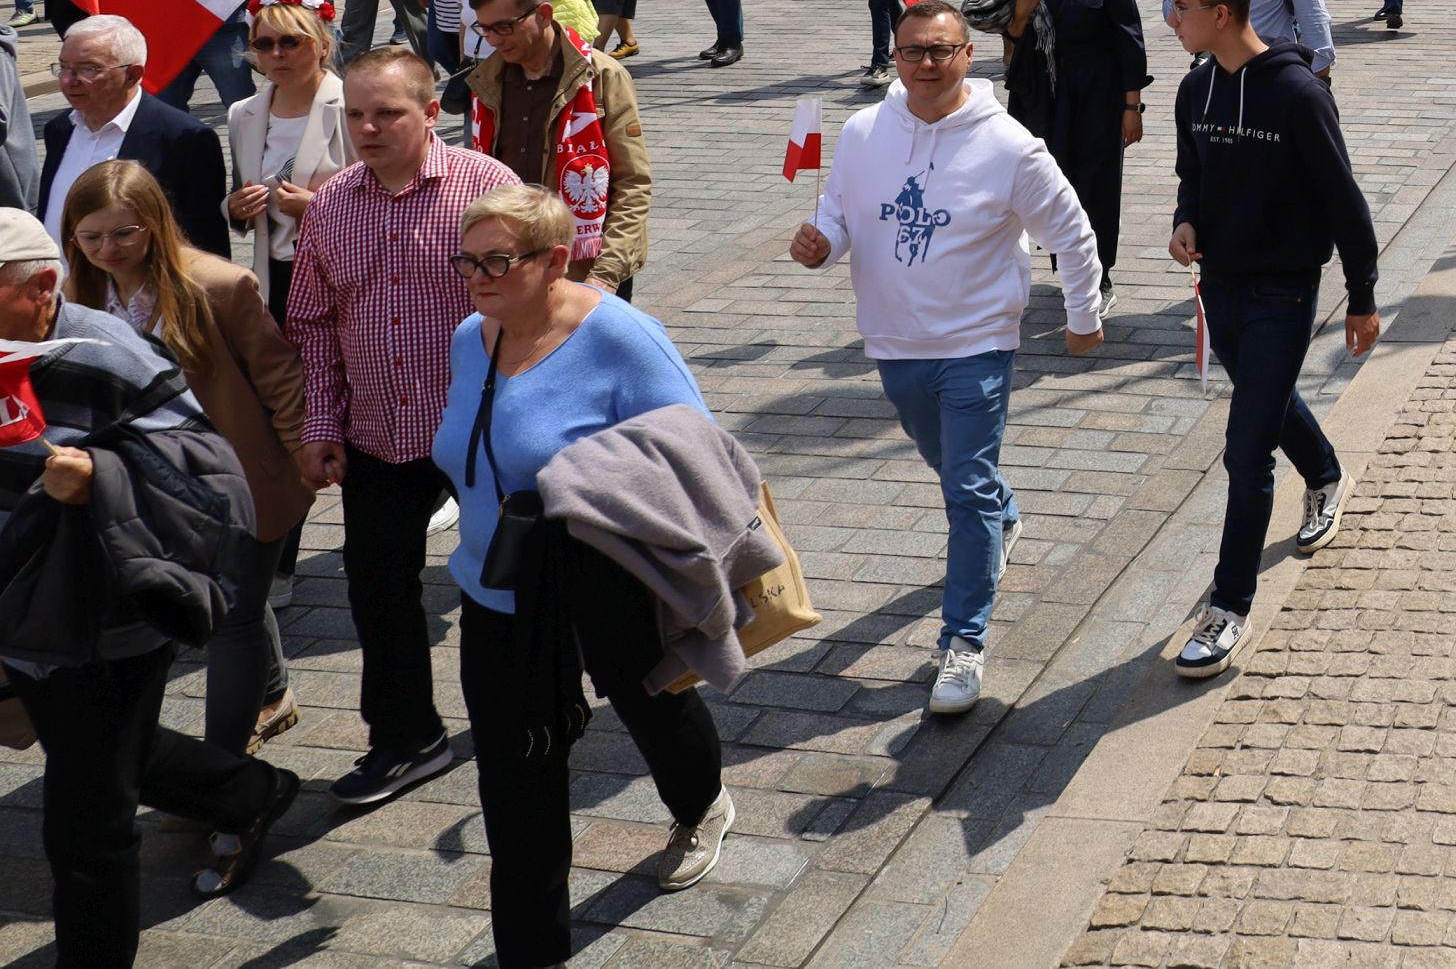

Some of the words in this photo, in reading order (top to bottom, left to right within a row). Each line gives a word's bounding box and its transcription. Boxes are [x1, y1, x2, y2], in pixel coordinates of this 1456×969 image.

[1192, 123, 1215, 132] OMMY
[1229, 125, 1280, 142] HILFIGER
[879, 203, 951, 227] POLO
[576, 223, 601, 235] ERW
[897, 225, 925, 244] 67
